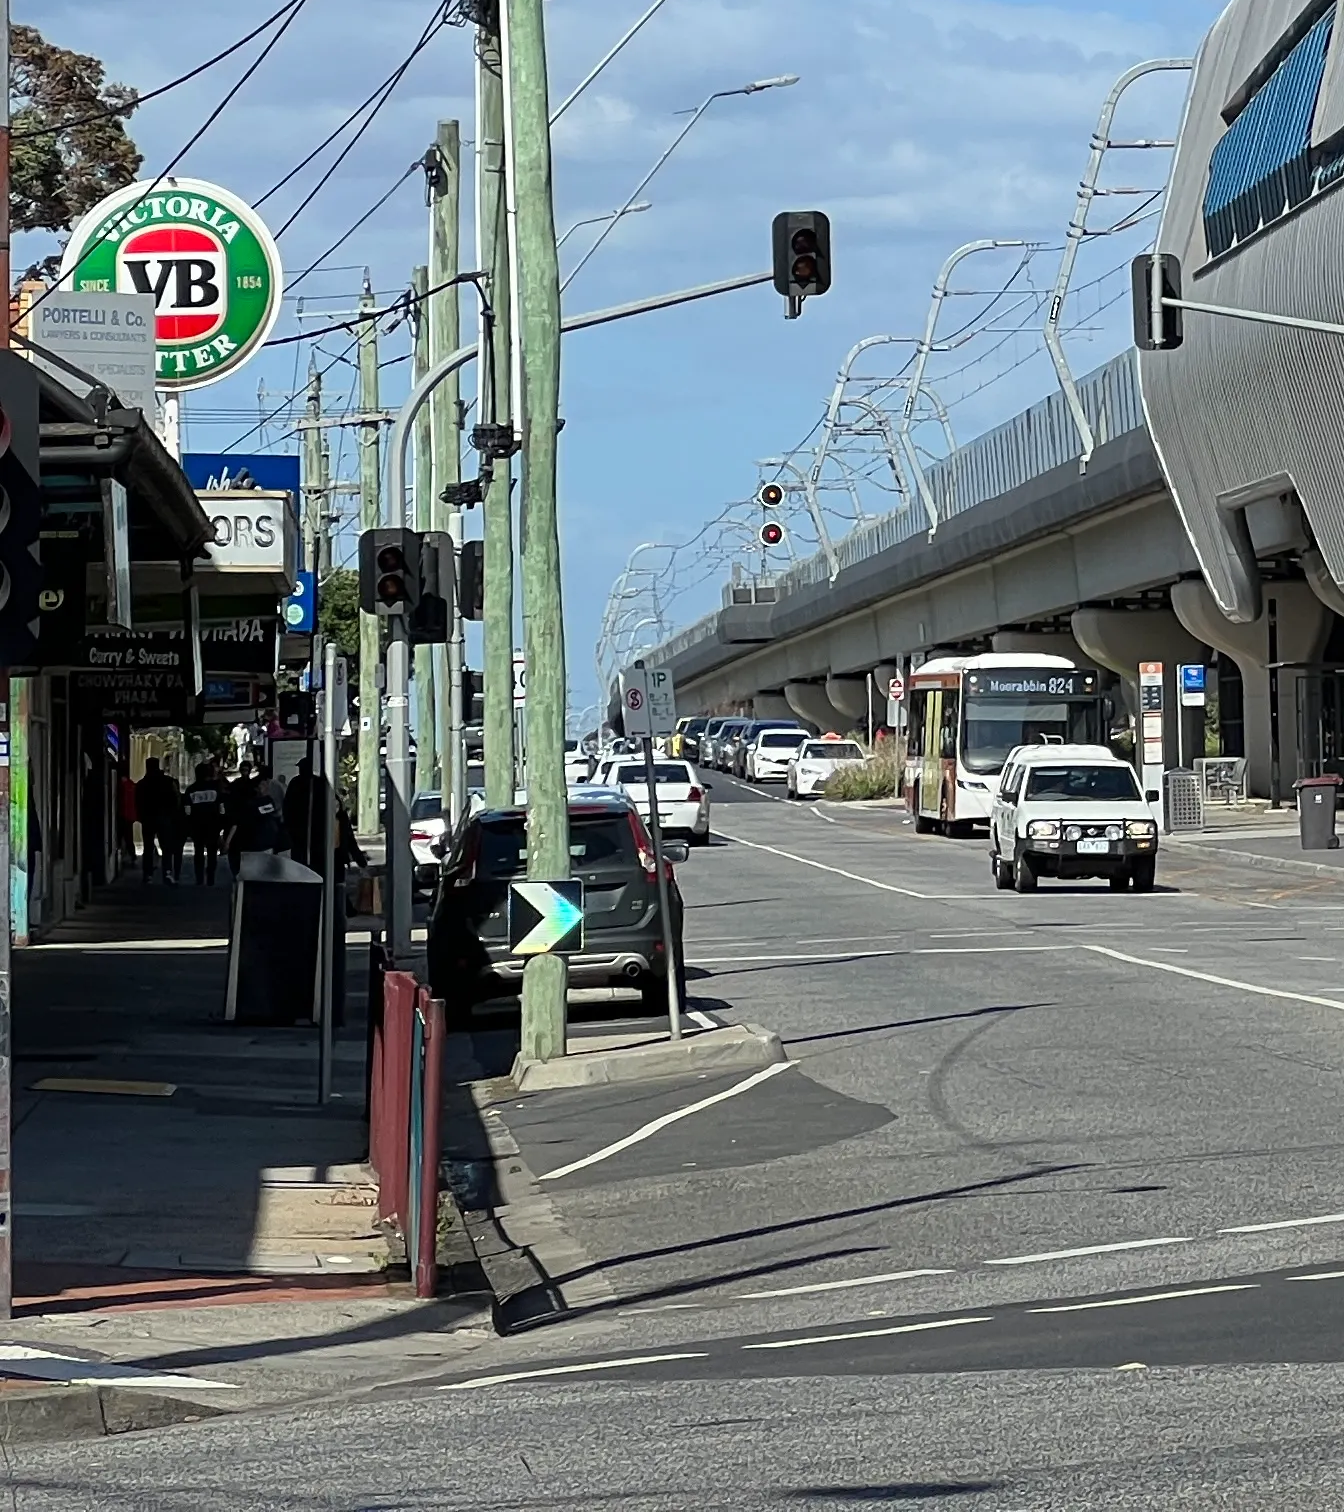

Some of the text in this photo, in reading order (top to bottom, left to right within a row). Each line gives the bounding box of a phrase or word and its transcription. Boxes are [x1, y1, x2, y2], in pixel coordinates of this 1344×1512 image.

[95, 196, 241, 245] VICTORIA
[123, 258, 219, 310] VB
[236, 275, 262, 289] 1854
[42, 307, 147, 327] PORTELLI & Co.
[41, 329, 80, 340] LAWYERS
[155, 334, 238, 372] TTER
[208, 515, 276, 548] ORS
[89, 647, 123, 666] Curry
[990, 677, 1073, 694] Moorabbin 824
